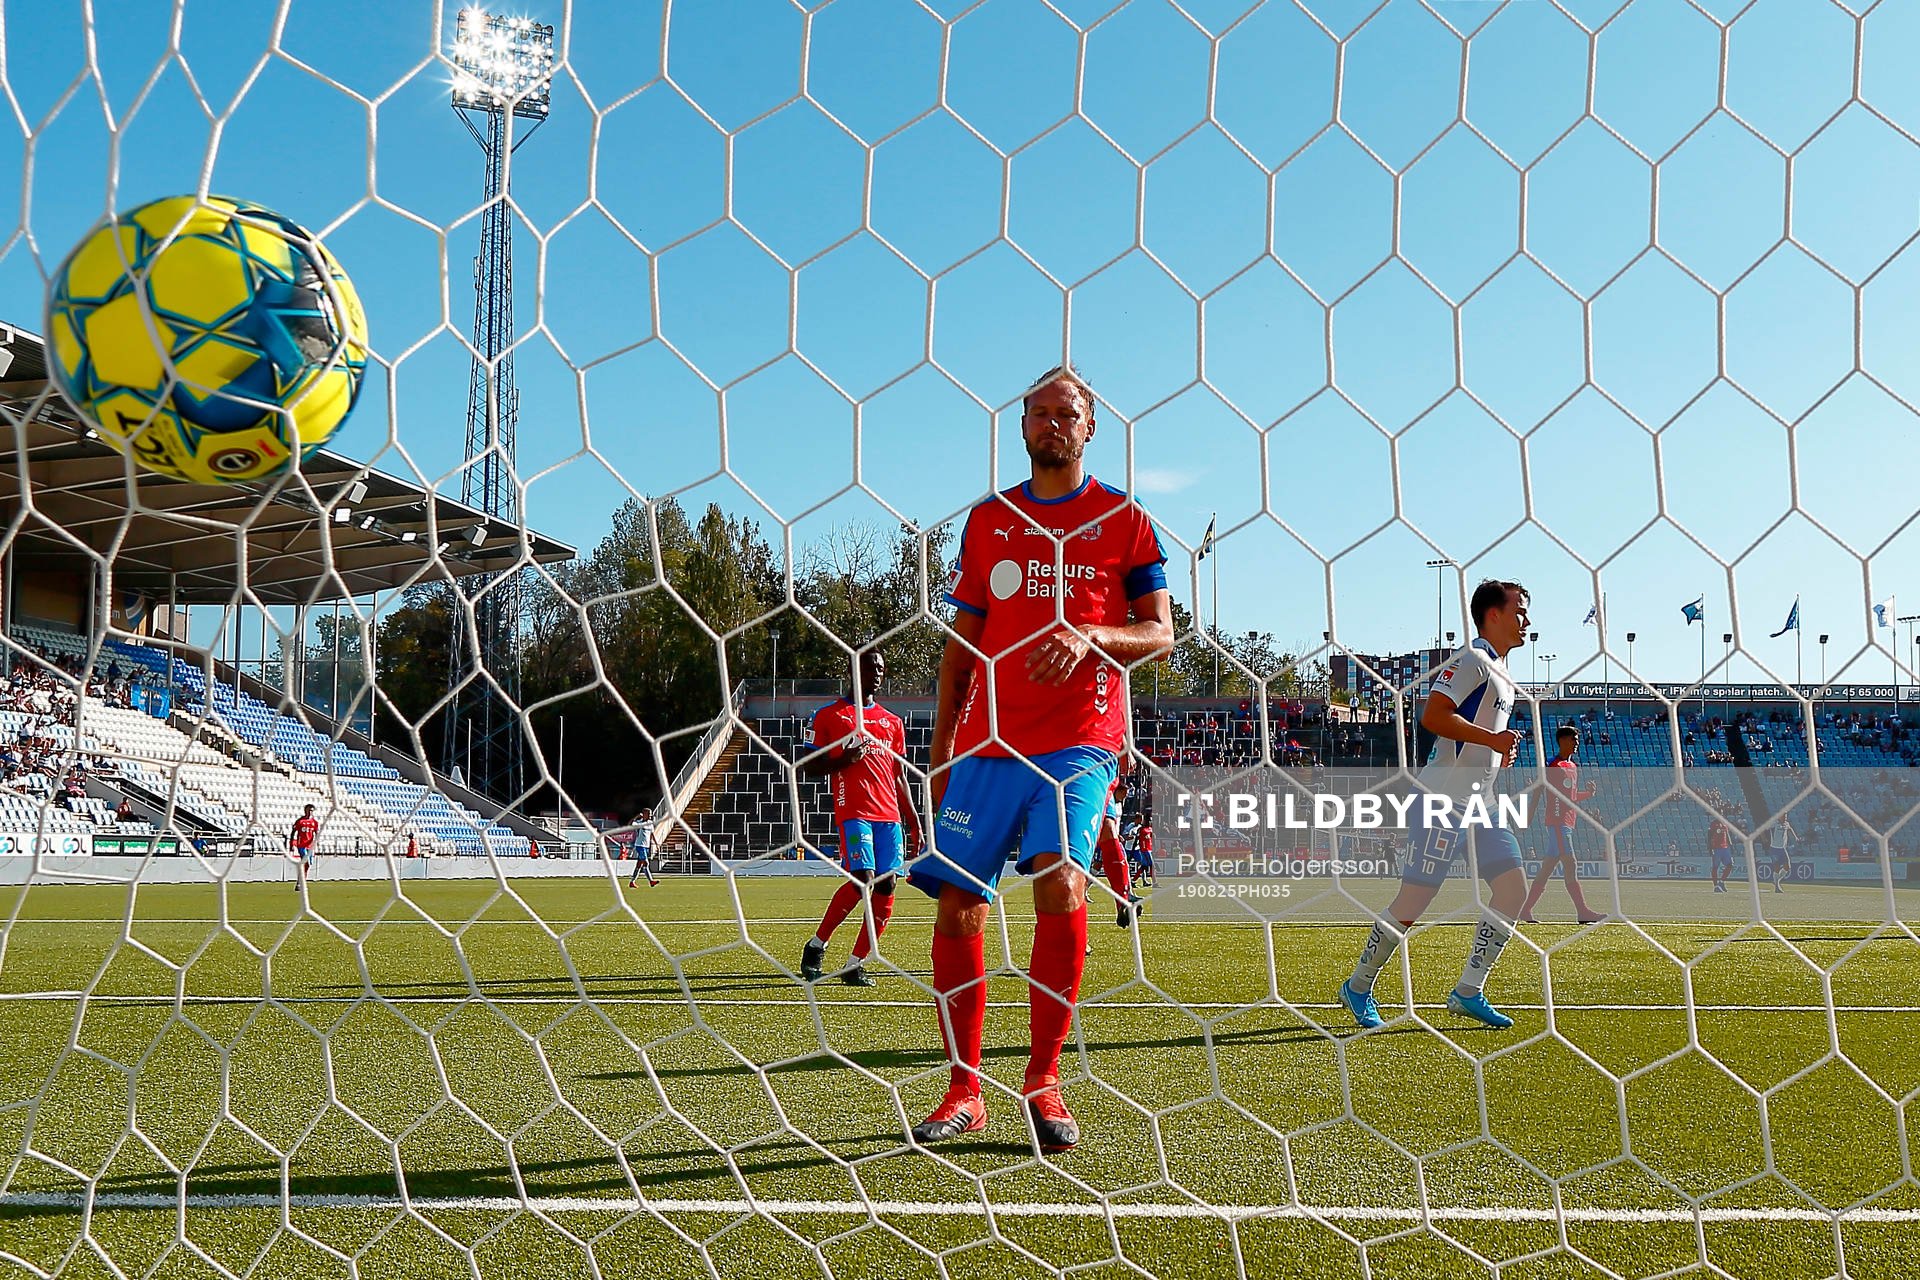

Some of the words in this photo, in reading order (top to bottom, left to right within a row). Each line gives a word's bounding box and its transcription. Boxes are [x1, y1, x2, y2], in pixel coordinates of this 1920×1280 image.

[1569, 686, 1579, 695] Vi
[1670, 686, 1687, 696] IFK
[1690, 687, 1710, 696] ine
[1713, 687, 1745, 698] spelar
[1747, 687, 1783, 696] match.
[1842, 687, 1855, 696] 45
[1858, 687, 1871, 696] 65
[1874, 687, 1894, 696] 000
[943, 806, 972, 825] Solid
[1422, 859, 1436, 875] 10
